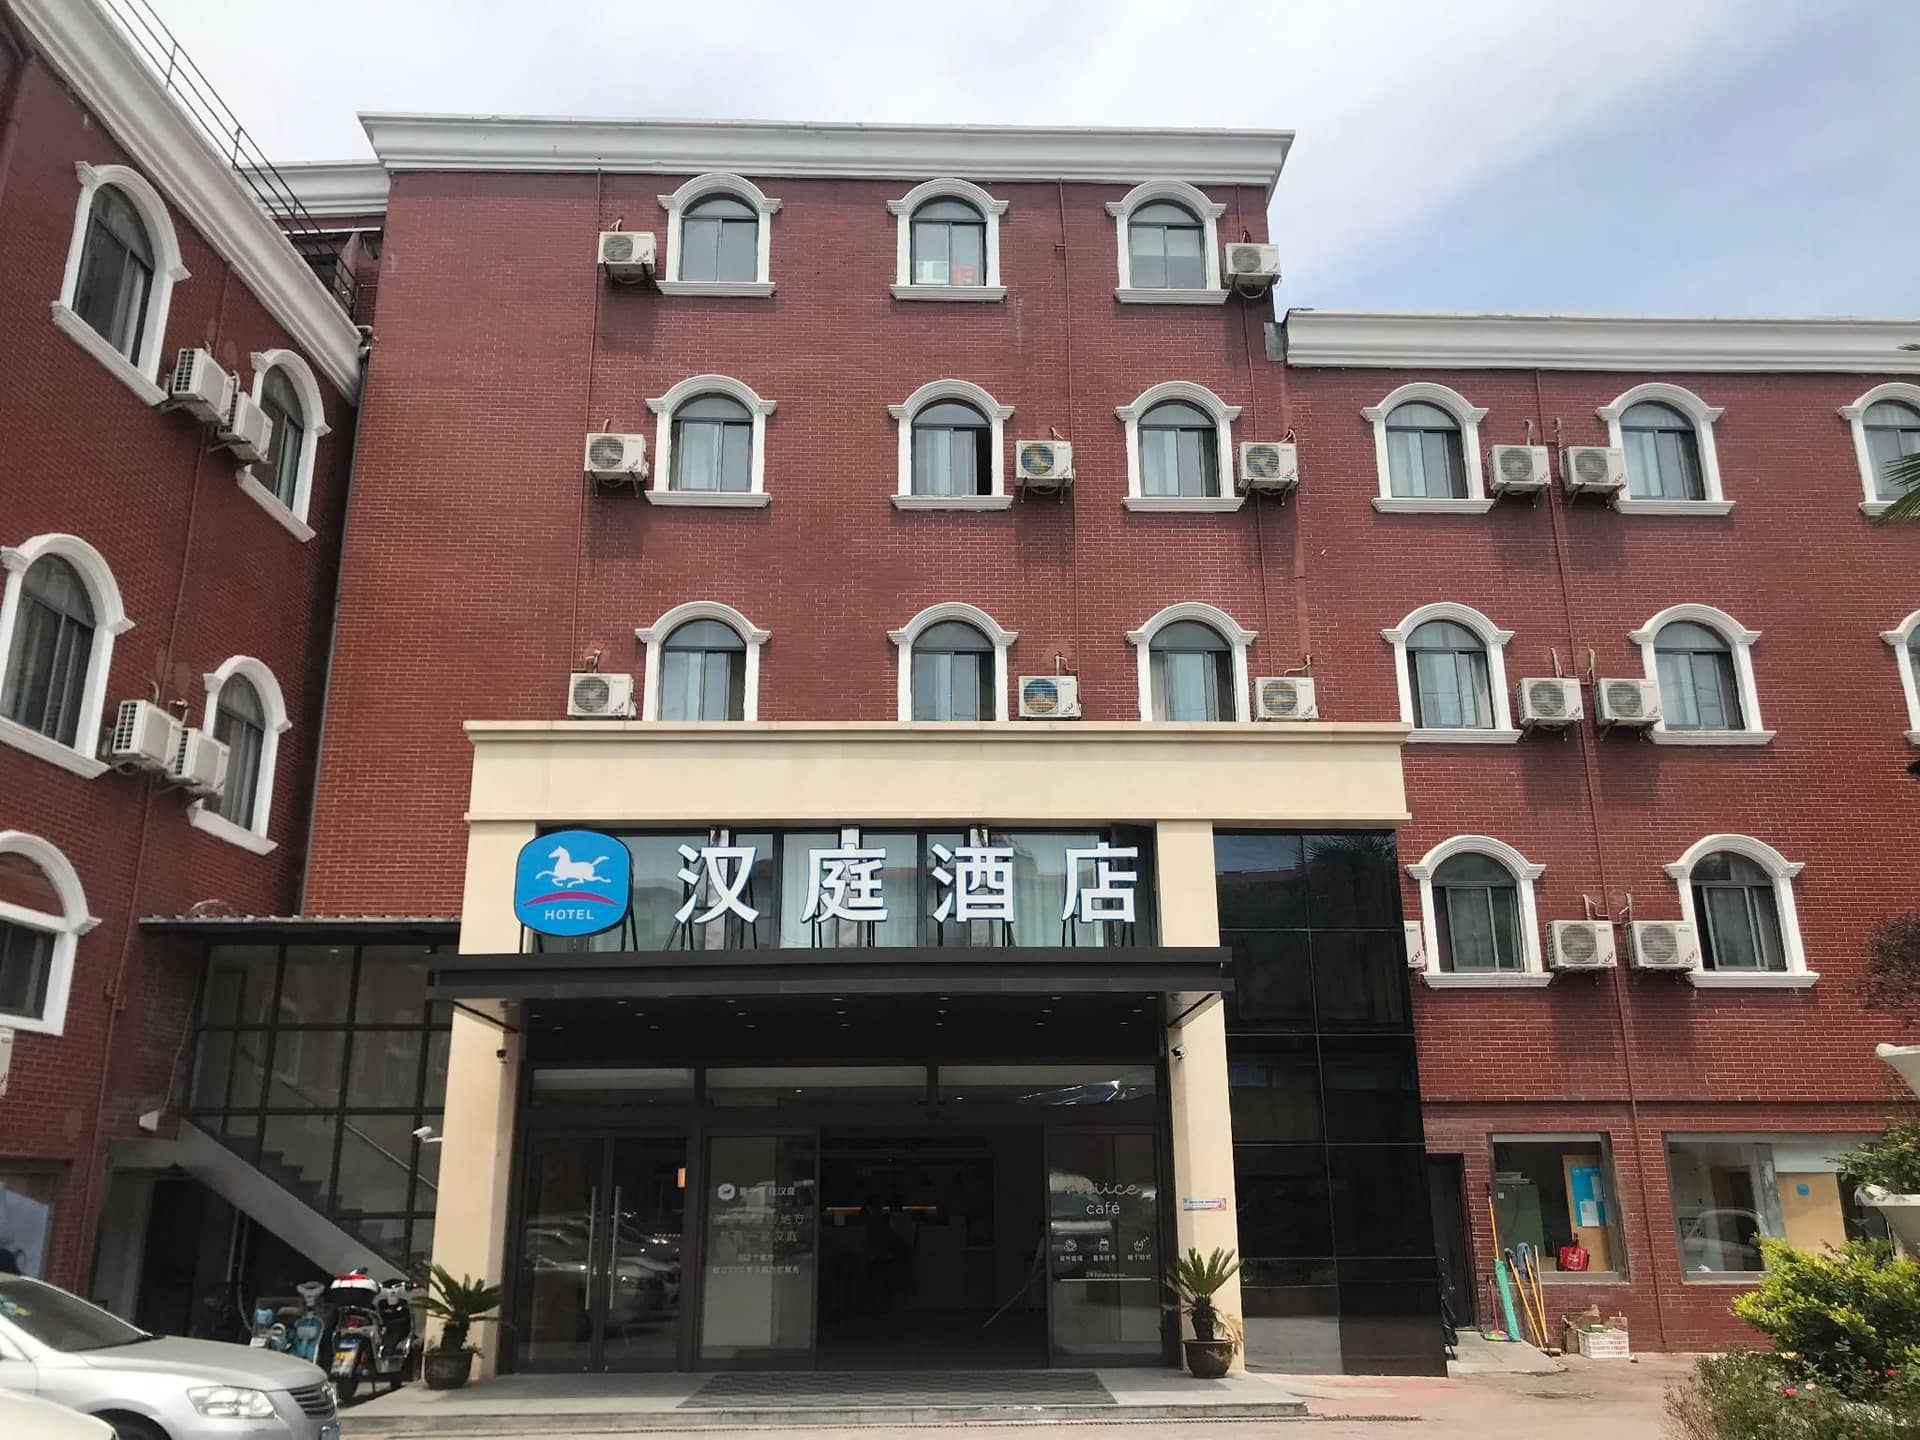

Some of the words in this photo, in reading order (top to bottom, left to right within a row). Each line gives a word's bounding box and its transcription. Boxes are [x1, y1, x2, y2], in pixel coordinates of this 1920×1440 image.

[675, 842, 1139, 925] 汉庭酒店
[545, 909, 595, 920] HOTEL
[1086, 1201, 1120, 1215] café
